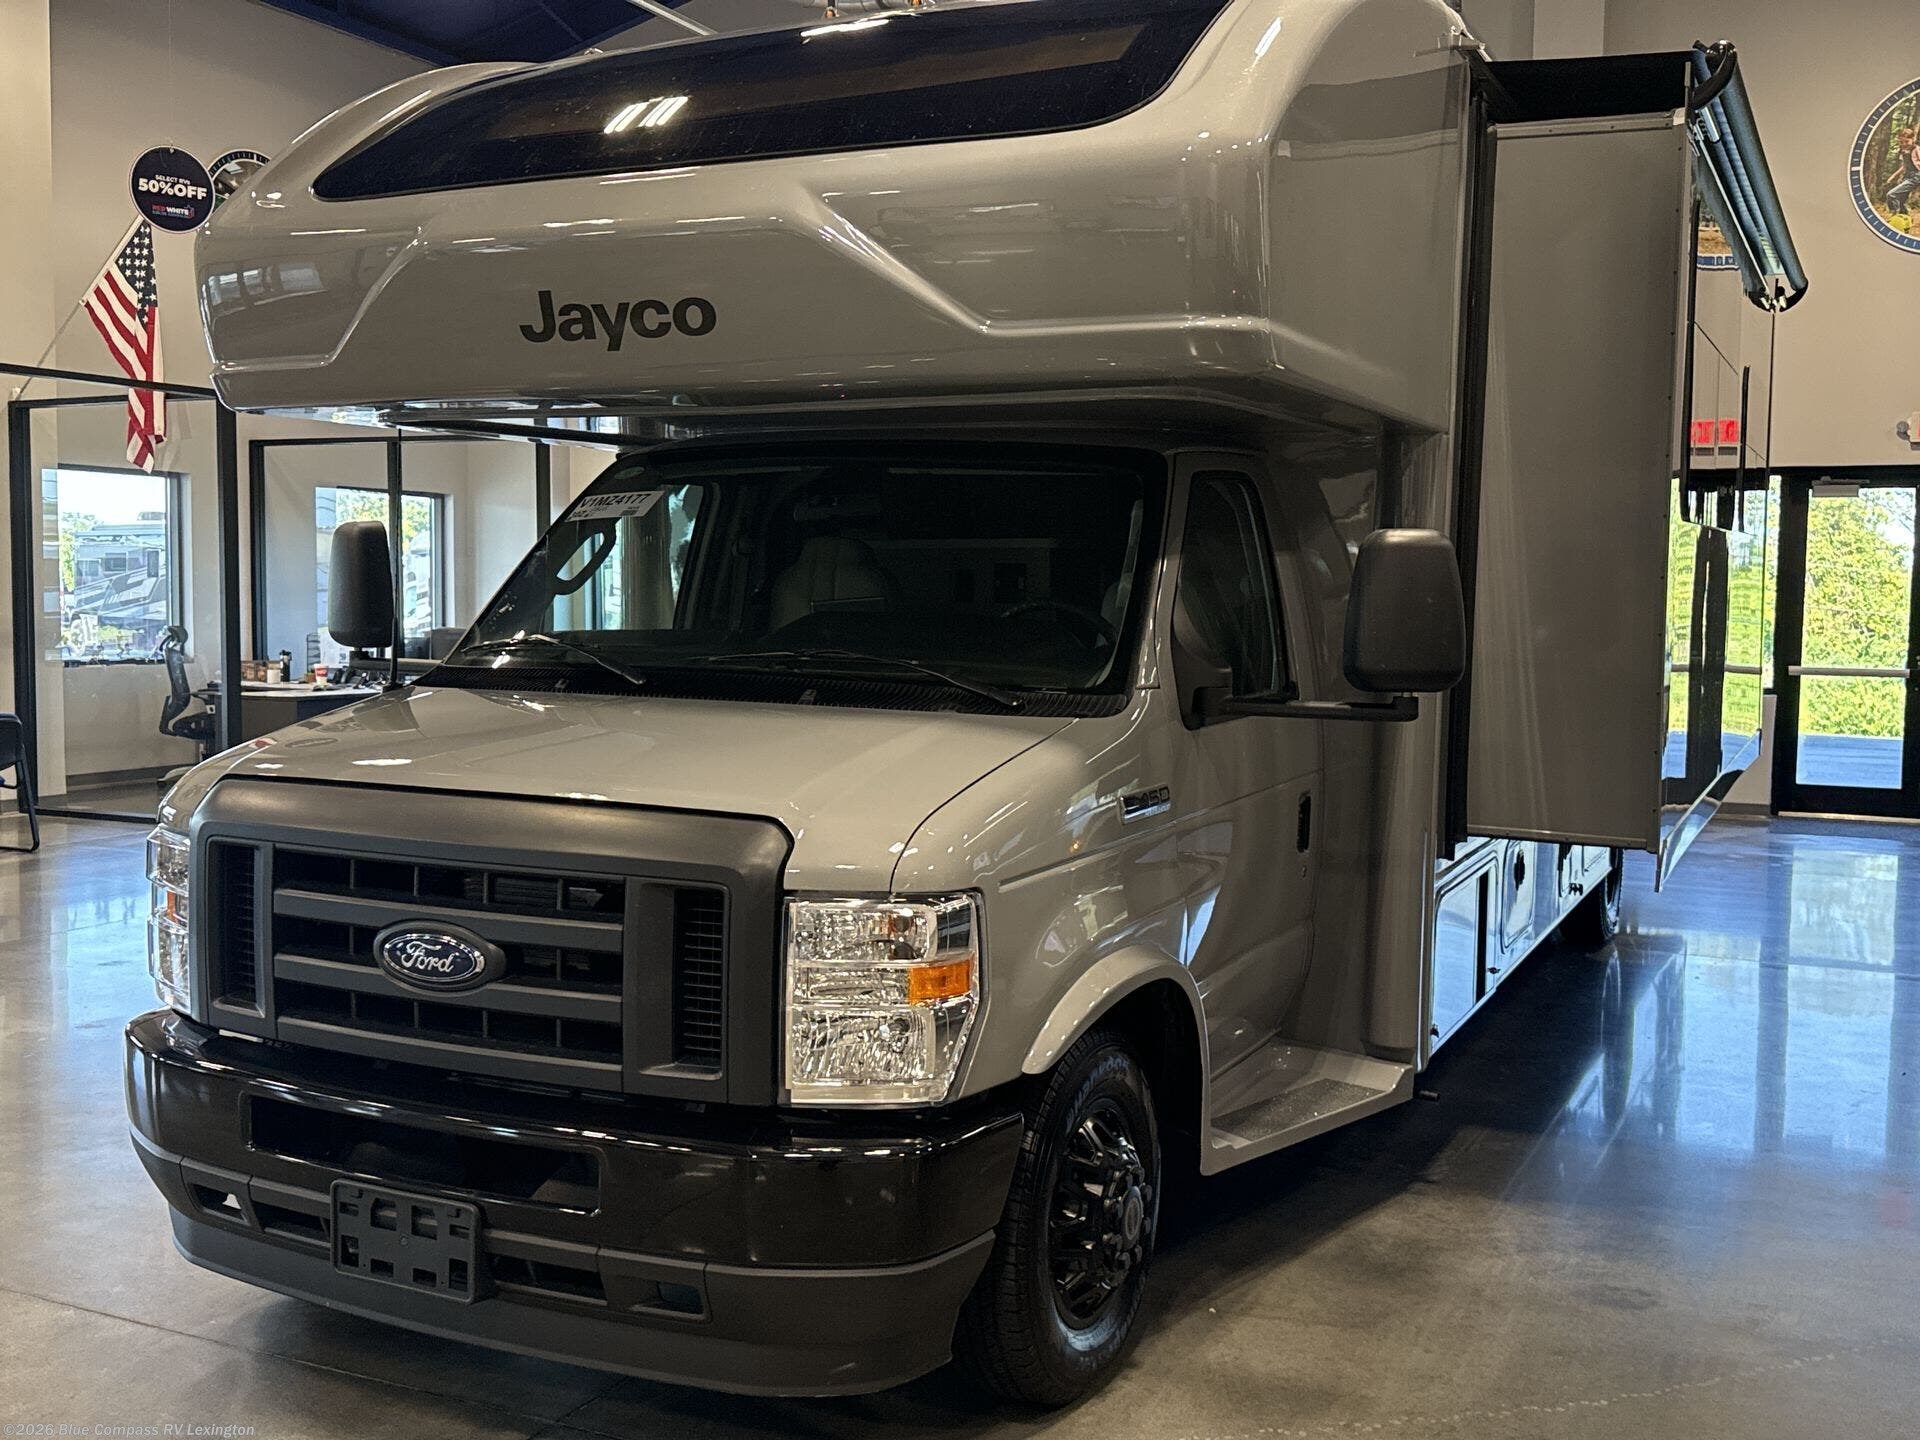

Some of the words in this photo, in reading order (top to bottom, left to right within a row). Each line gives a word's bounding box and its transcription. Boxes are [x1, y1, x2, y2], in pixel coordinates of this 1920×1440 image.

[155, 174, 178, 183] SELECT
[519, 289, 717, 351] Jayco
[401, 941, 460, 973] Ford
